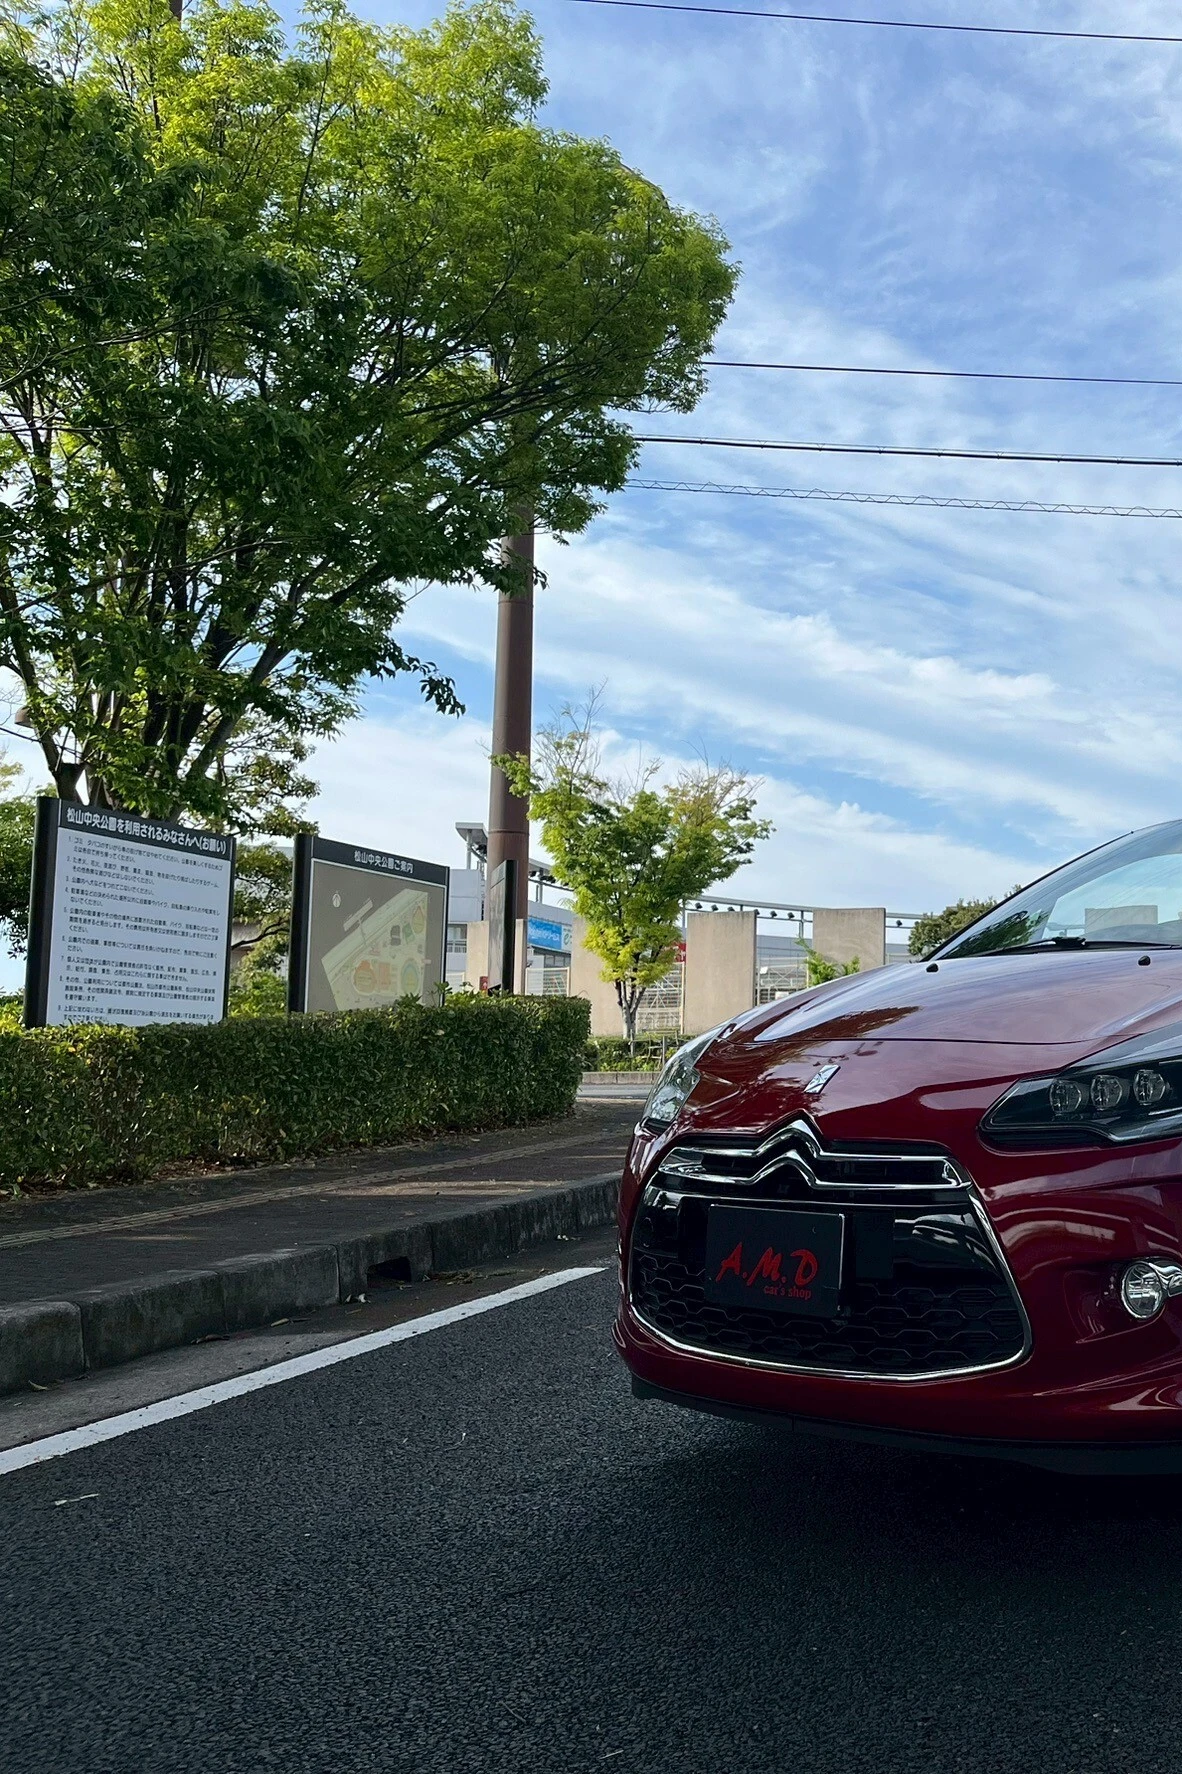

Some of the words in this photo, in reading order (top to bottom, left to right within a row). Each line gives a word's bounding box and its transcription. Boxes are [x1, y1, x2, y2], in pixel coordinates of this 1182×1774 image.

[354, 850, 414, 874] 松山中央公園ご案内
[763, 1284, 786, 1297] car's
[788, 1286, 812, 1300] shop
